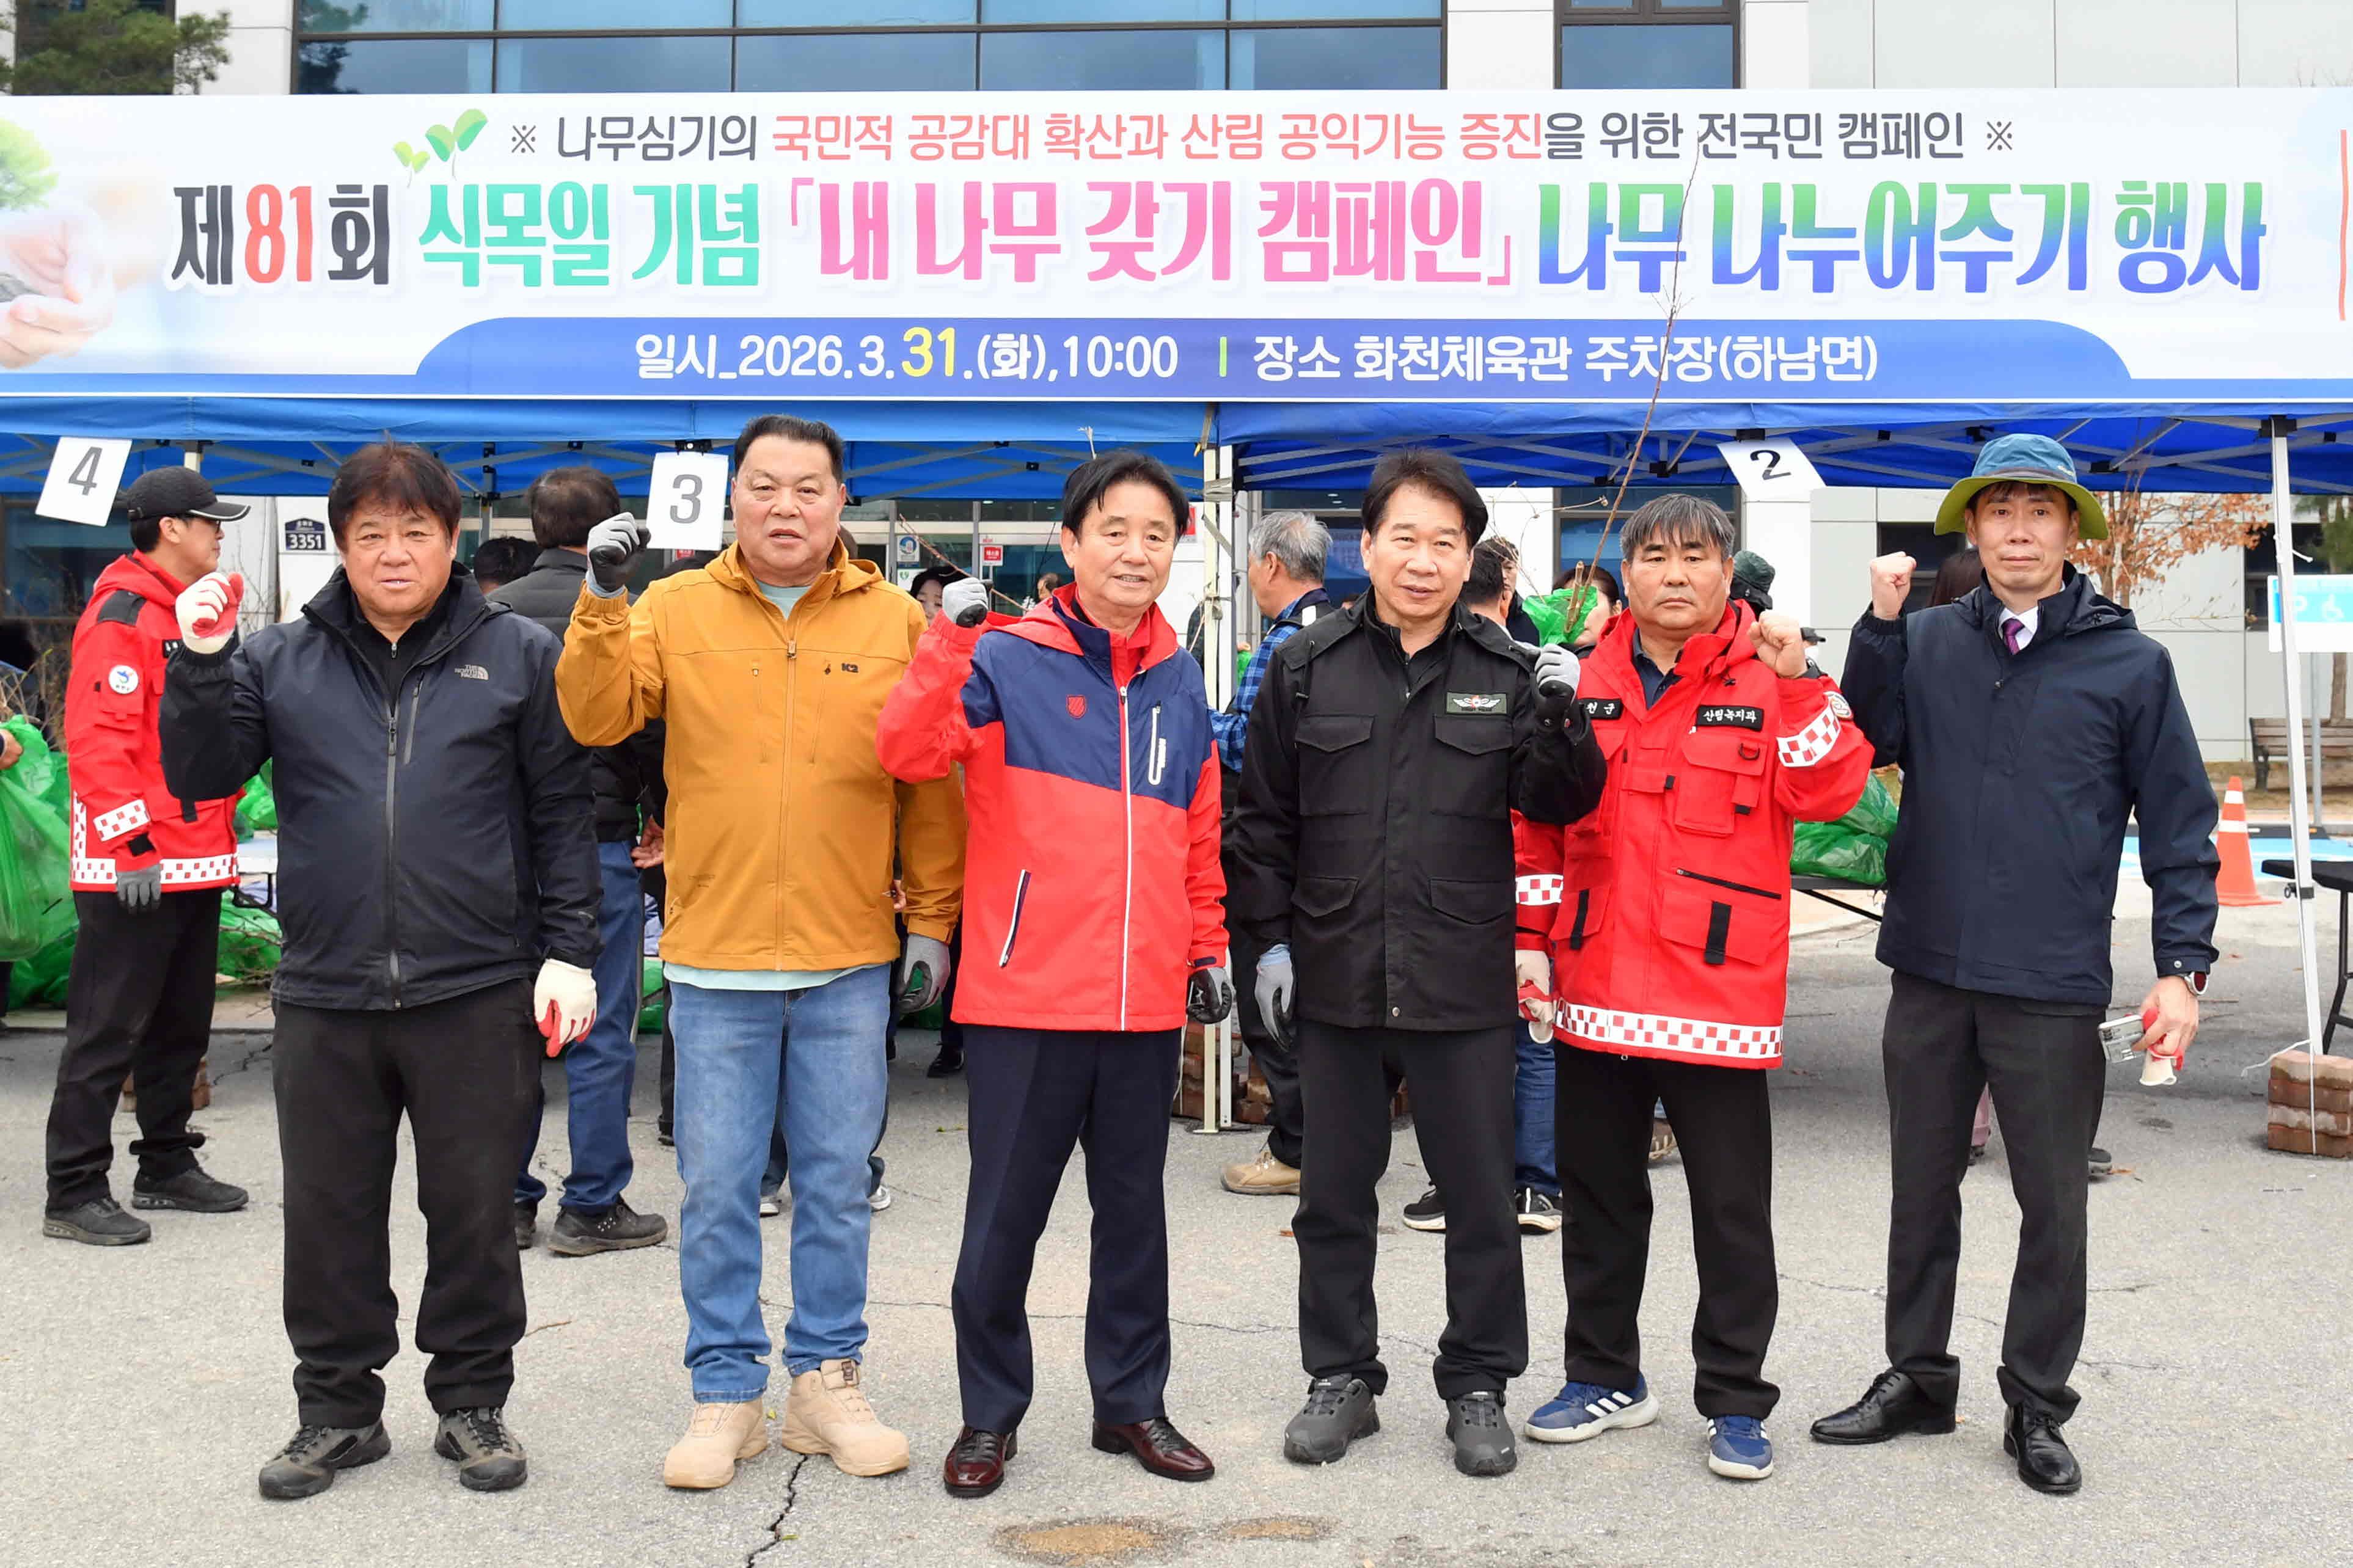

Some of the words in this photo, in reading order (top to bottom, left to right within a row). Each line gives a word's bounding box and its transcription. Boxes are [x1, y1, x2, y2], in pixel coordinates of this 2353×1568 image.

[558, 115, 757, 161] 나무심기의
[772, 114, 892, 161] 국민적
[908, 114, 1030, 161] 공감대
[1044, 113, 1169, 161] 확산과
[1181, 113, 1263, 160] 산림
[1278, 113, 1445, 160] 공익기능
[1459, 112, 1585, 160] 증진을
[1600, 112, 1683, 159] 위한
[1697, 112, 1824, 159] 전국민
[1838, 112, 1964, 159] 캠페인
[170, 183, 391, 286] 제81회
[419, 181, 609, 287] 식목일
[632, 183, 759, 286] 기념
[791, 177, 889, 280] 「내
[915, 181, 1061, 283] 나무
[1085, 180, 1231, 282] 갖기
[1257, 178, 1511, 286] 캠페인」
[1539, 182, 1686, 293] 나무
[1711, 180, 2090, 293] 나누어주기
[2115, 180, 2267, 294] 행사
[1253, 335, 1341, 381] 장소
[1353, 335, 1573, 382] 화천체육관
[1586, 335, 1878, 382] 주차장(하남면)
[68, 447, 103, 496] 4
[1749, 449, 1791, 481] 2
[669, 474, 703, 523] 3
[288, 534, 322, 549] 3351
[841, 663, 858, 673] K2
[1702, 708, 1757, 723] 산림녹지과
